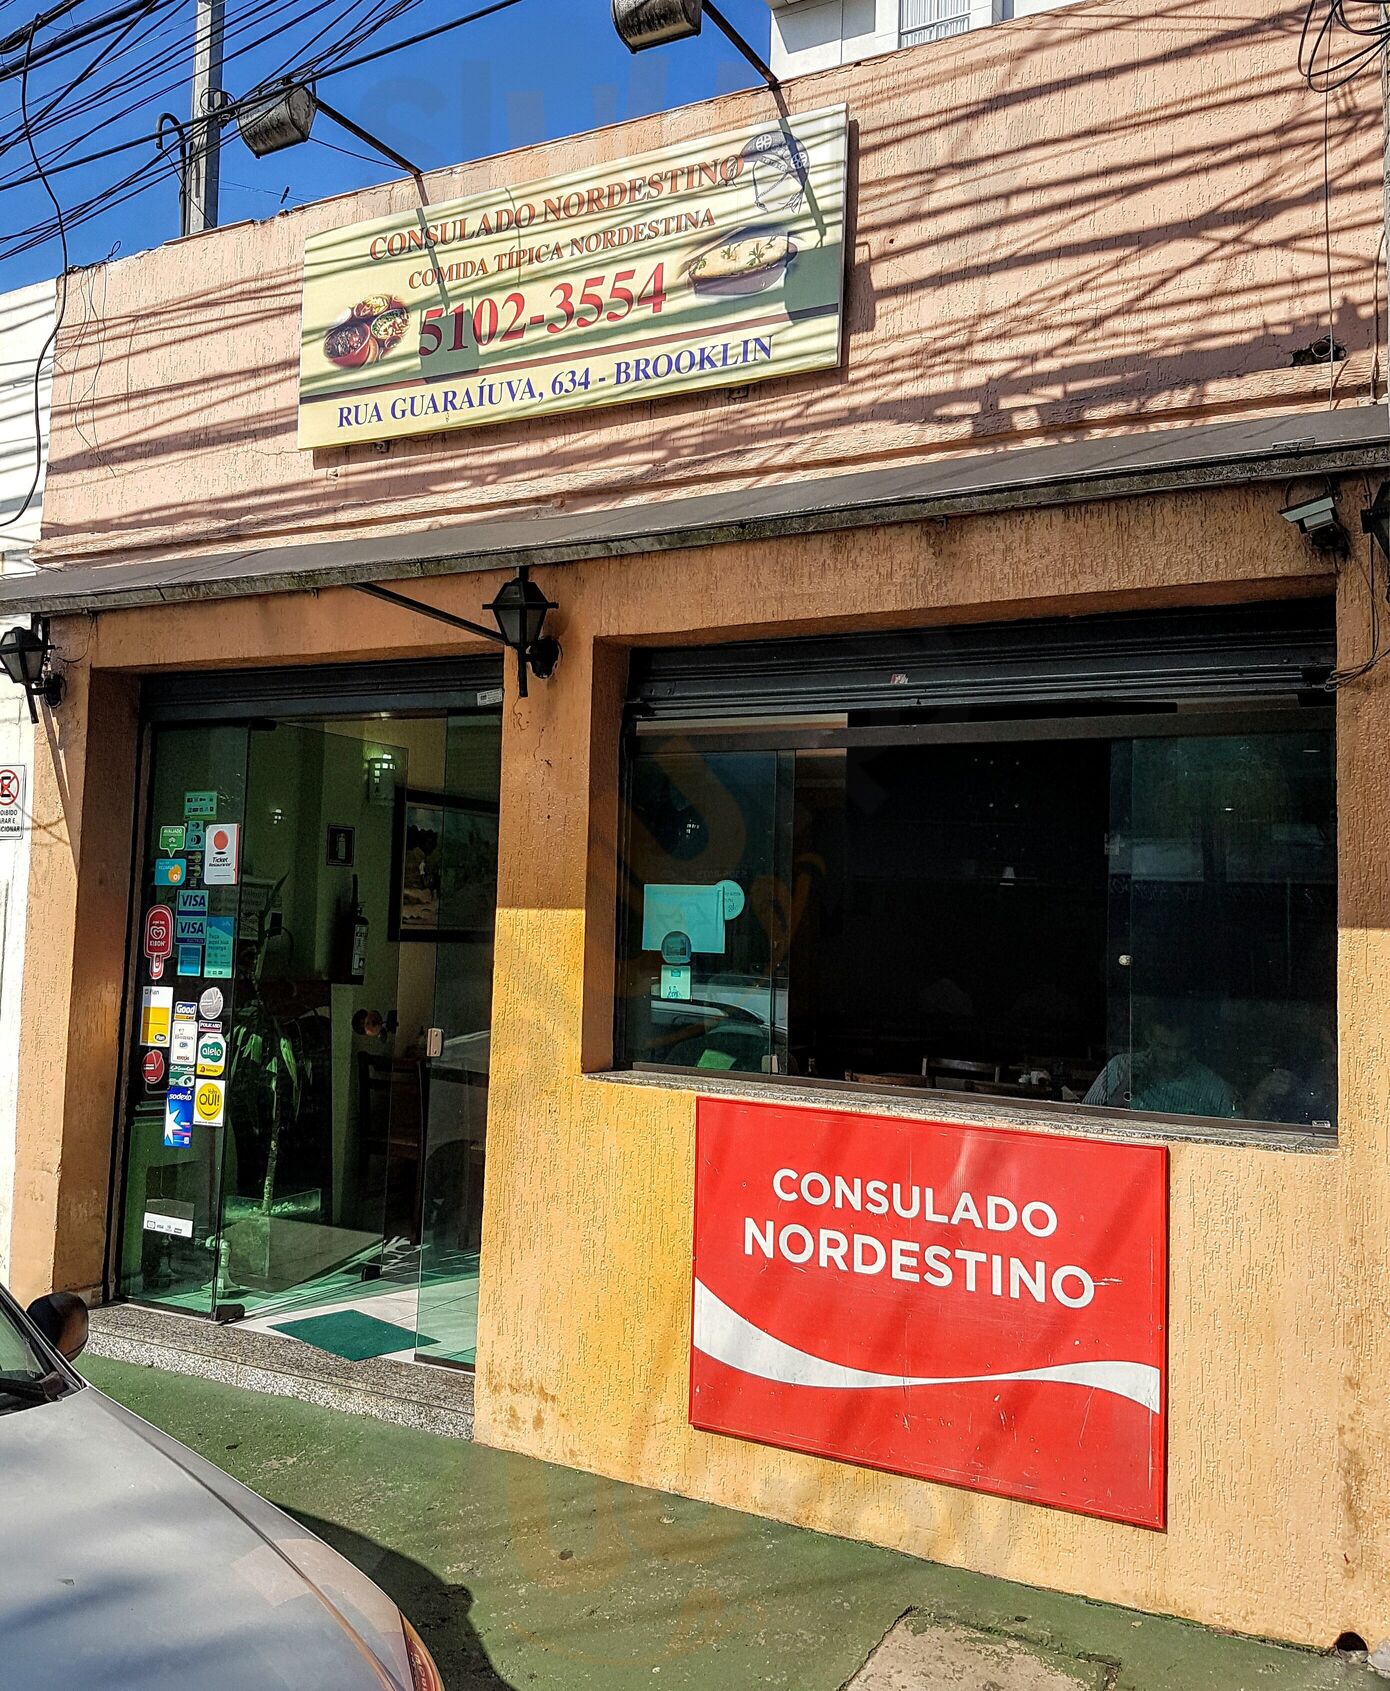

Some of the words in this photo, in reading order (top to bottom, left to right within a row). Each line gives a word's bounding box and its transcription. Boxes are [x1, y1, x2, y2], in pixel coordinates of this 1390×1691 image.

[370, 203, 536, 261] CONSULADO
[543, 153, 745, 224] NORDESTINO
[408, 257, 489, 290] COMIDA
[494, 245, 564, 273] TÍPICA
[570, 207, 716, 257] NORDESTINA
[417, 262, 667, 357] 5102-3554
[337, 402, 383, 429] RUA
[390, 377, 544, 421] GUARAÍUVA,
[551, 367, 591, 396] 634
[613, 334, 775, 387] BROOKLIN
[179, 921, 204, 934] VISA
[181, 894, 206, 907] VISA
[176, 1005, 196, 1014] Good
[168, 1092, 192, 1101] sodexo
[772, 1167, 1059, 1239] CONSULADO
[743, 1216, 1096, 1310] NORDESTINO
